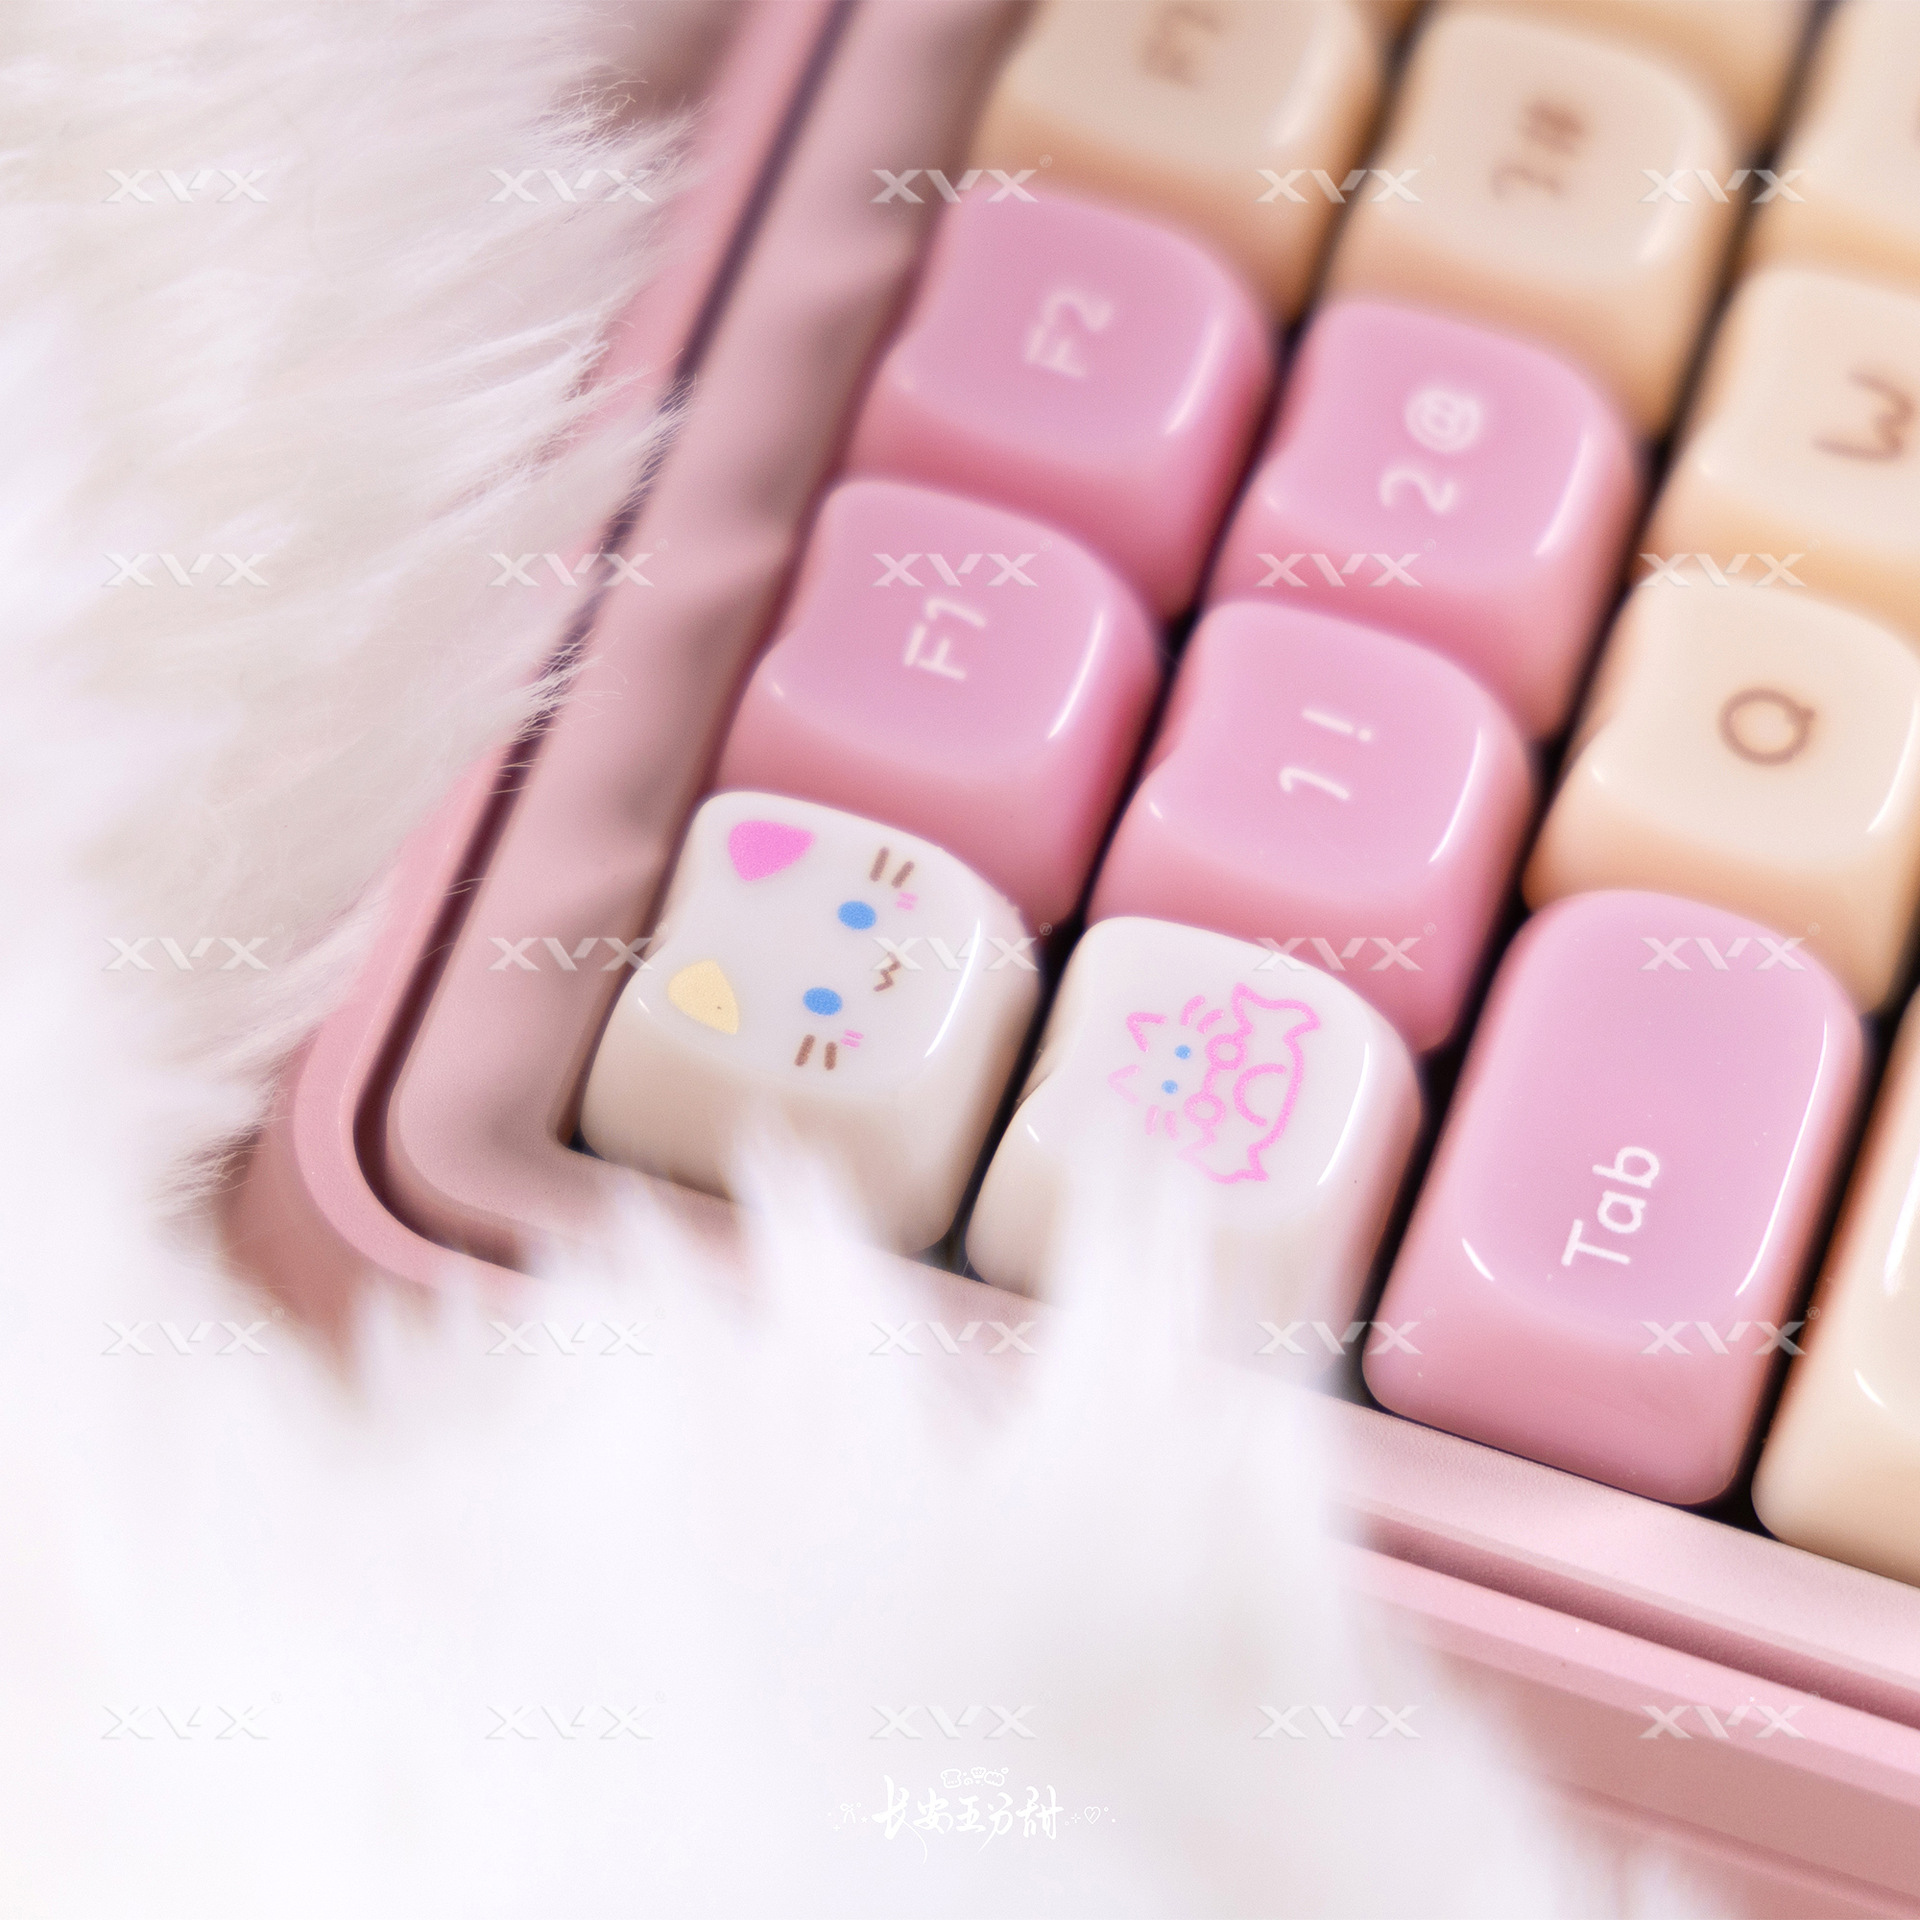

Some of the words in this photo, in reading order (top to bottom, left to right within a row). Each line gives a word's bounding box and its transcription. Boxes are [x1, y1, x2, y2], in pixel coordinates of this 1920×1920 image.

[1026, 290, 1112, 377] F2
[904, 598, 984, 680] F1
[1719, 687, 1816, 766] Q
[1561, 1146, 1660, 1266] Tab
